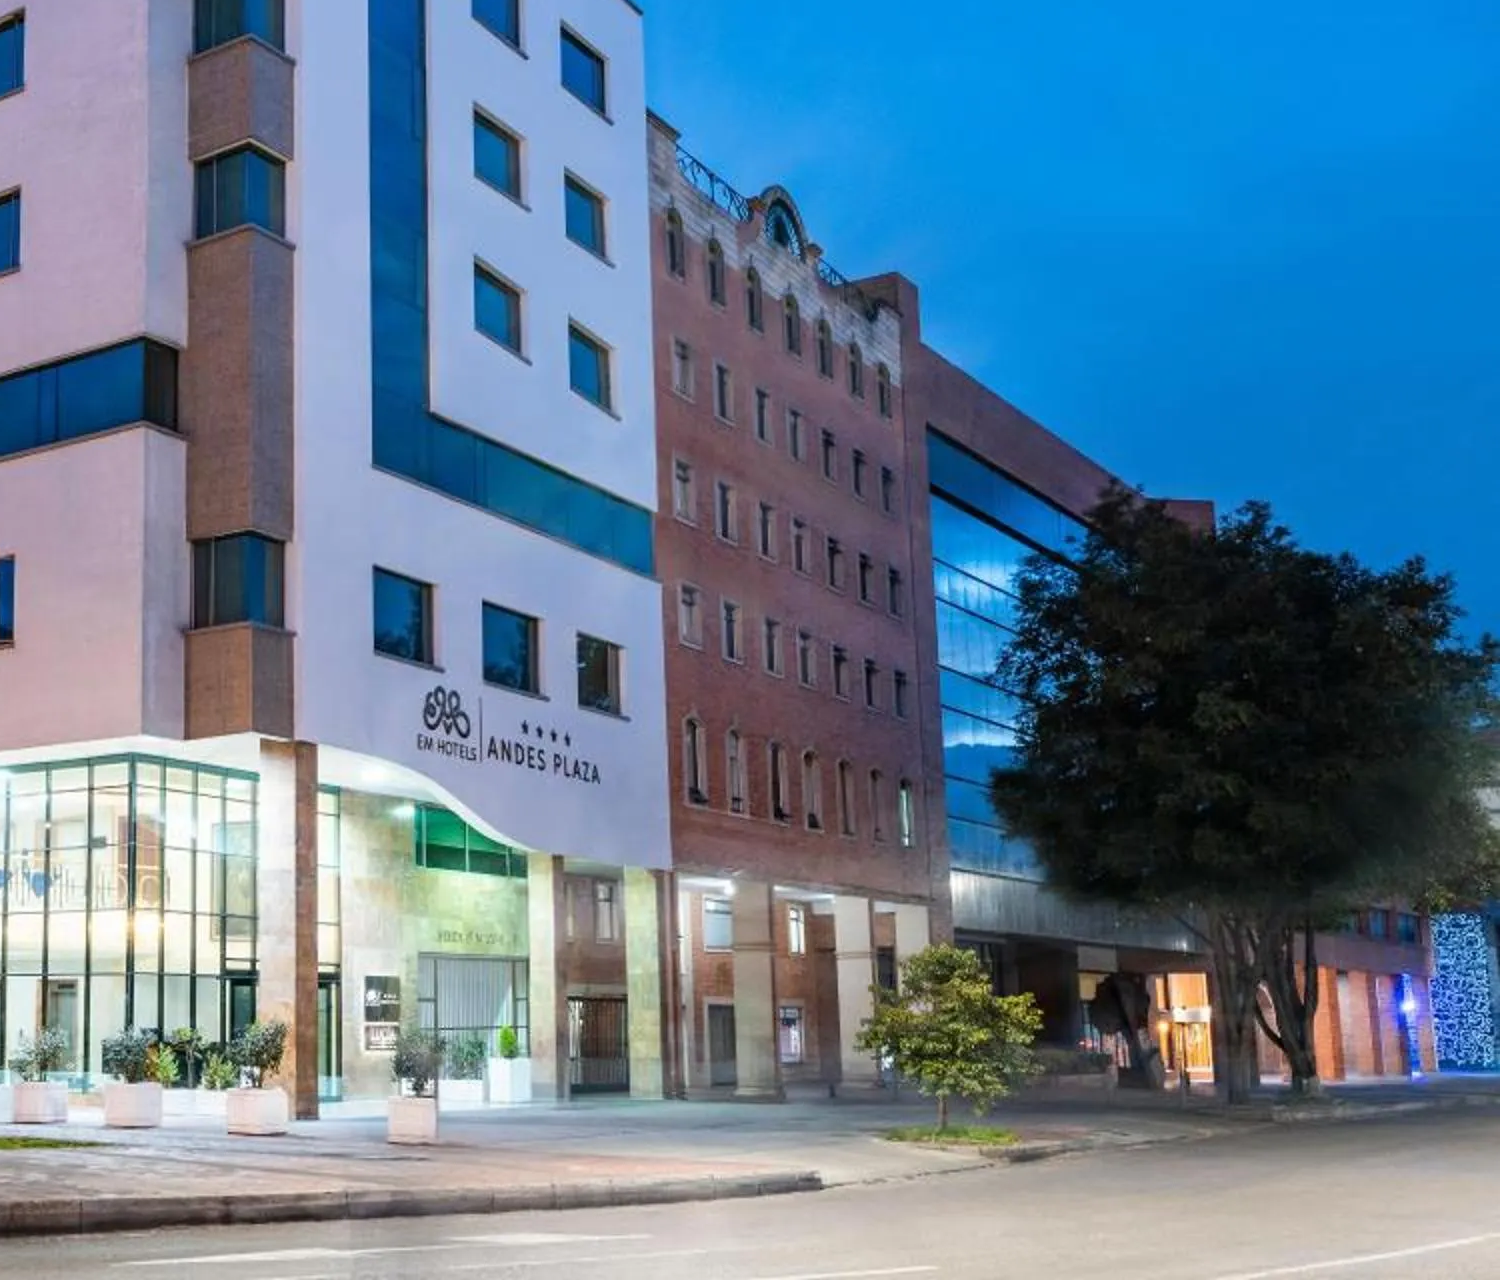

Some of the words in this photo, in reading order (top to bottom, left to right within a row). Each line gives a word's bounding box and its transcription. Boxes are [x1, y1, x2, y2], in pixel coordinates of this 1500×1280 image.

[417, 733, 433, 751] EM
[437, 739, 477, 761] HOTELS
[487, 736, 547, 771] ANDES
[553, 753, 601, 785] PLAZA
